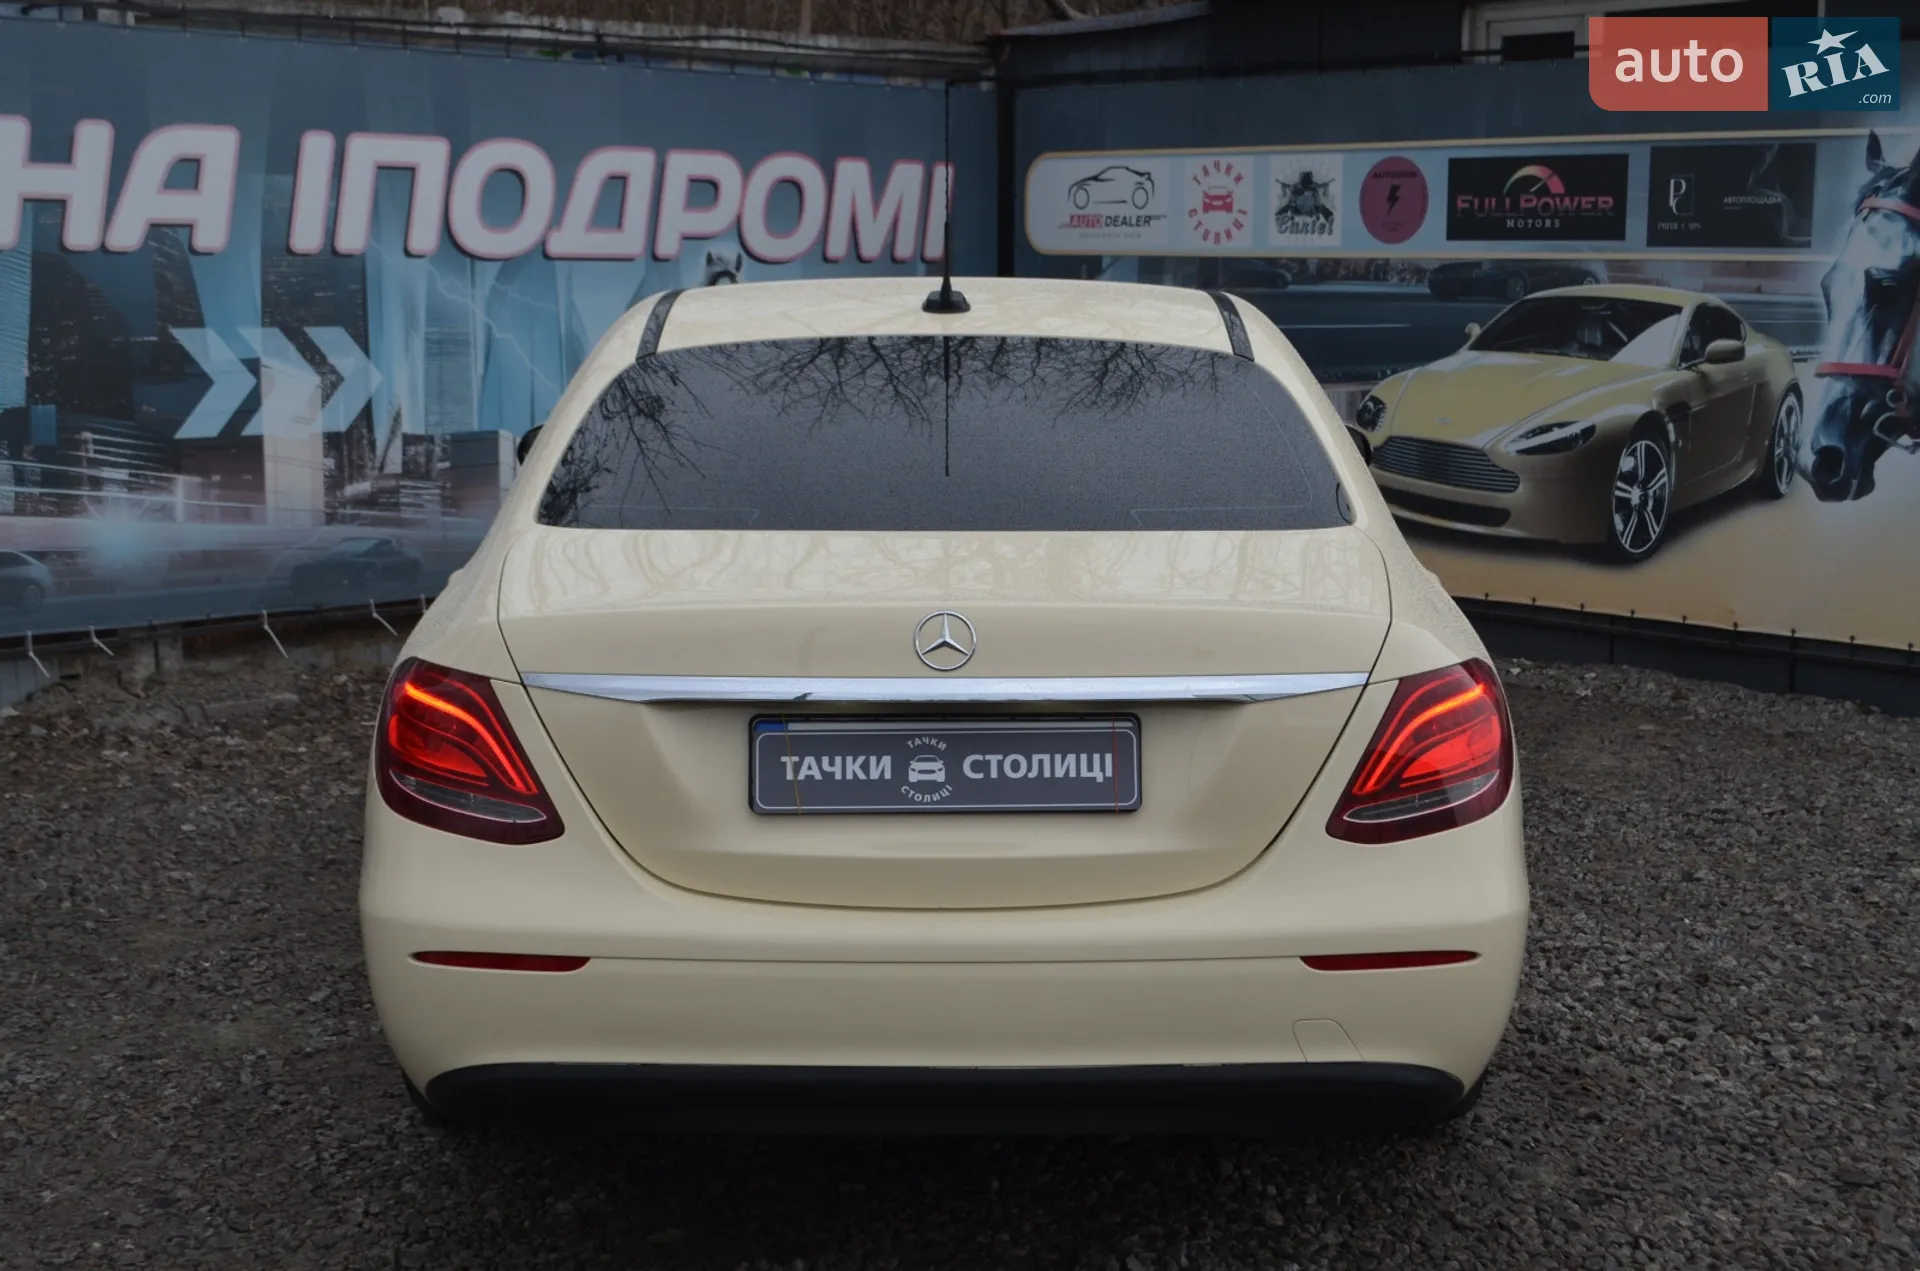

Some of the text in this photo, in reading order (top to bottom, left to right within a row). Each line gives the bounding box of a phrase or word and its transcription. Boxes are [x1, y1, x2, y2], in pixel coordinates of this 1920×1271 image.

[0, 113, 955, 264] НА ІПОДРОМІ
[1104, 214, 1152, 228] DEALER
[1506, 219, 1561, 229] MOTORS
[907, 736, 947, 751] ТАЧКИ
[780, 755, 892, 781] ТАЧКИ
[962, 753, 1113, 783] СТОЛИЦІ
[901, 784, 953, 803] СТОЛИЦІ
